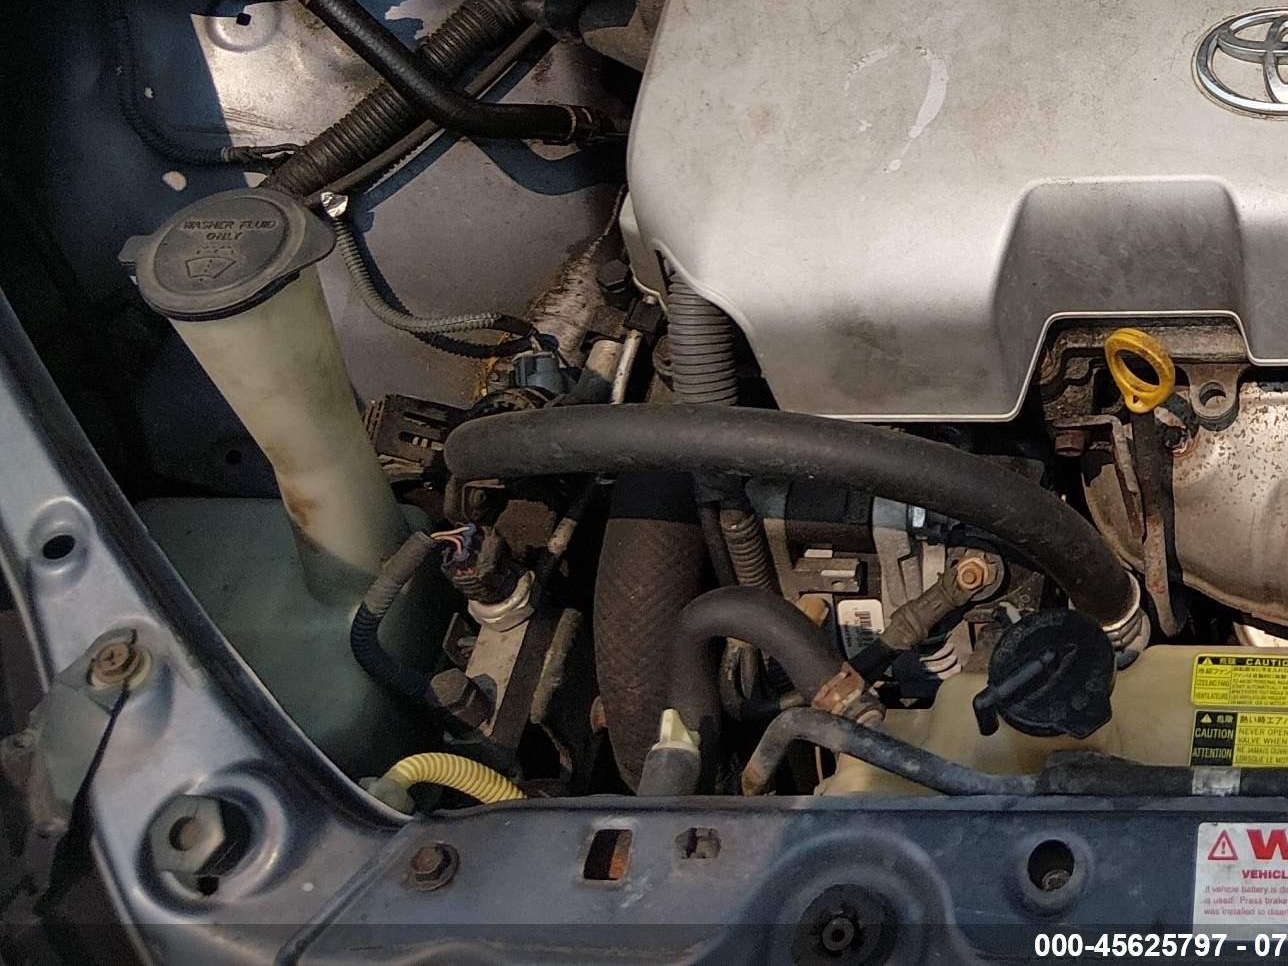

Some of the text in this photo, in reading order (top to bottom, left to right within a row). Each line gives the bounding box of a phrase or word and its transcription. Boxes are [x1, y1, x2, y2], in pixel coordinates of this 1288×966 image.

[184, 220, 276, 230] WASHER FLUID
[206, 232, 243, 241] ONLY
[1195, 727, 1234, 739] CAUTION
[1239, 728, 1264, 736] NEVER
[1192, 747, 1233, 759] ATTENTION
[1241, 886, 1268, 895] battery
[1240, 897, 1262, 905] Press
[1265, 897, 1288, 905] brake
